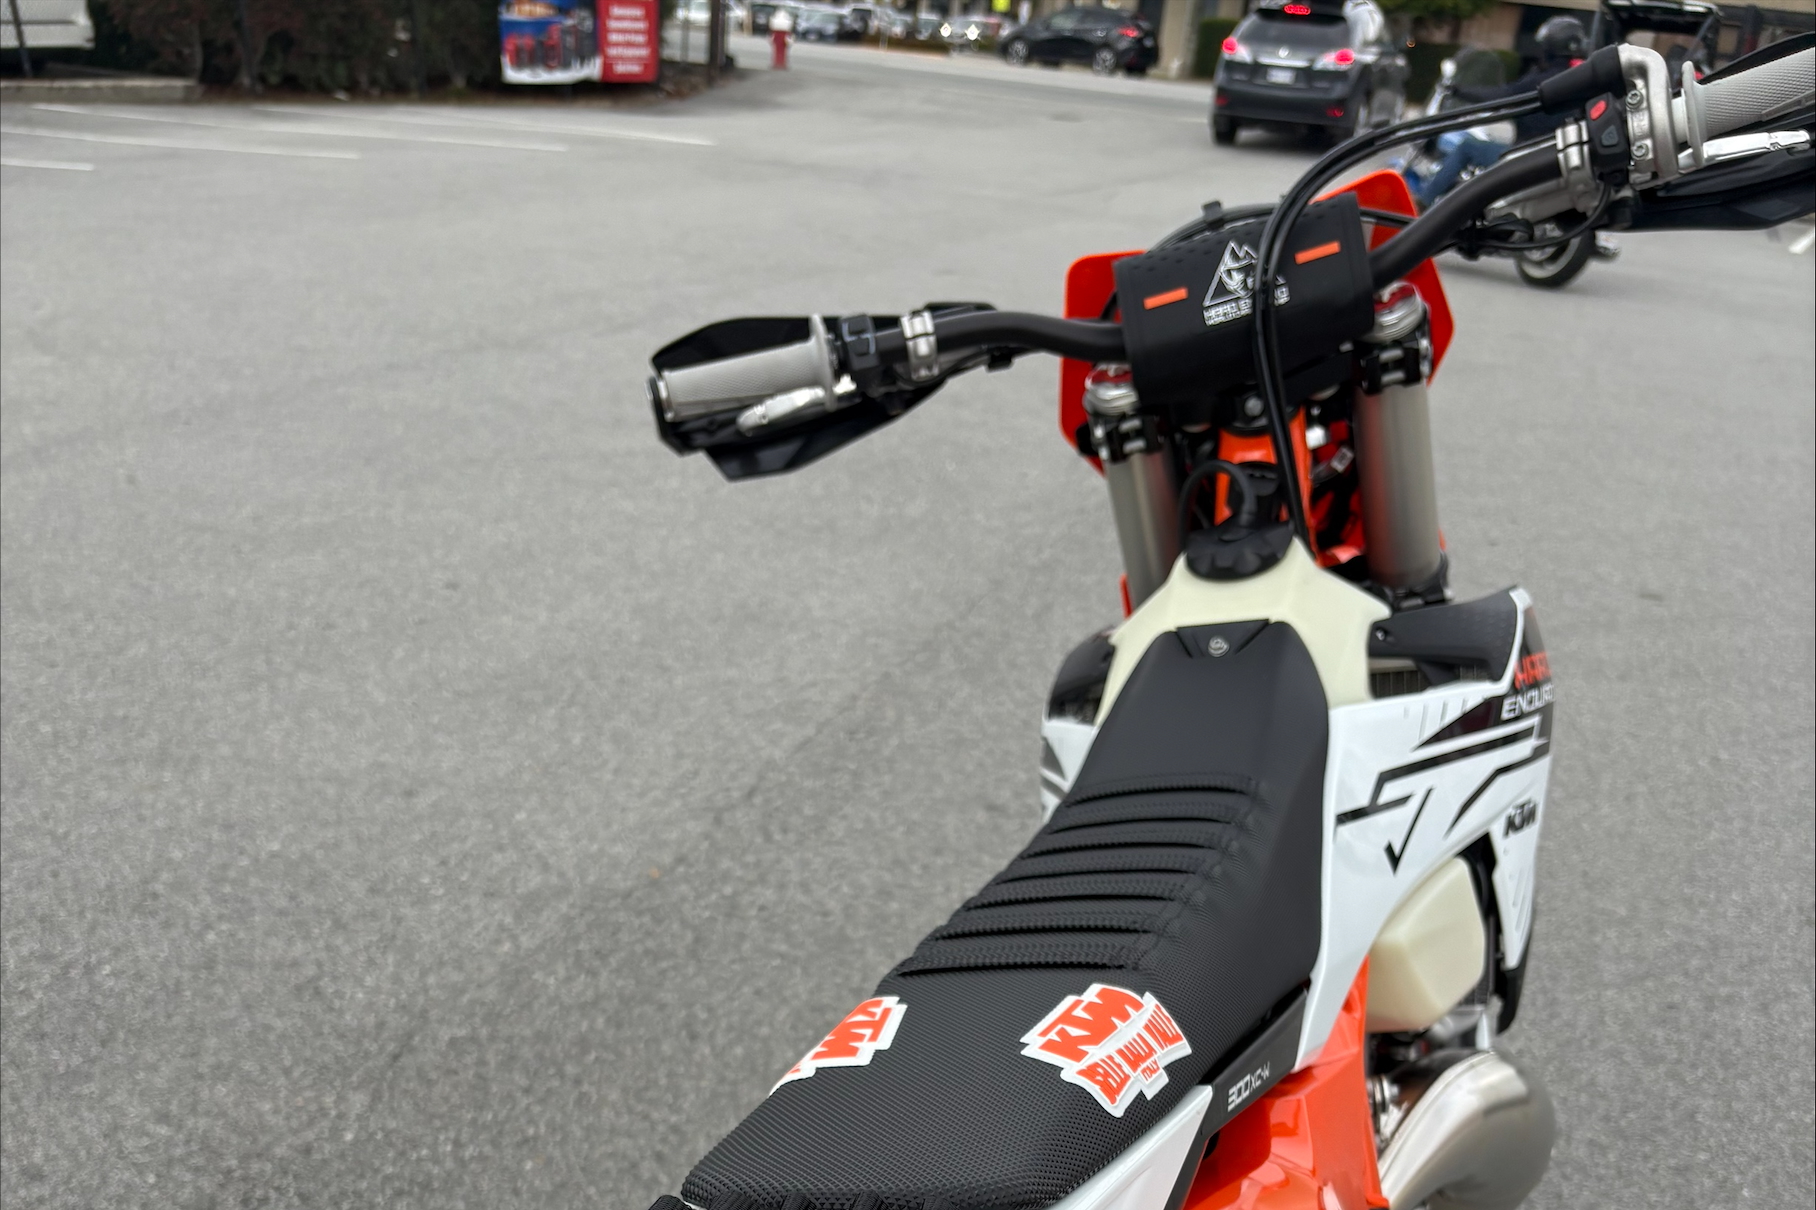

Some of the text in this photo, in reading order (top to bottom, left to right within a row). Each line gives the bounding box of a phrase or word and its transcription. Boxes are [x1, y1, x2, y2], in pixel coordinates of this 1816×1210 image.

[1504, 798, 1538, 838] KTM
[1037, 987, 1146, 1063] KTM
[1115, 1033, 1158, 1074] DALLA
[1142, 1003, 1184, 1052] VALLE
[1140, 1058, 1160, 1081] ITALY
[1227, 1073, 1250, 1112] 300
